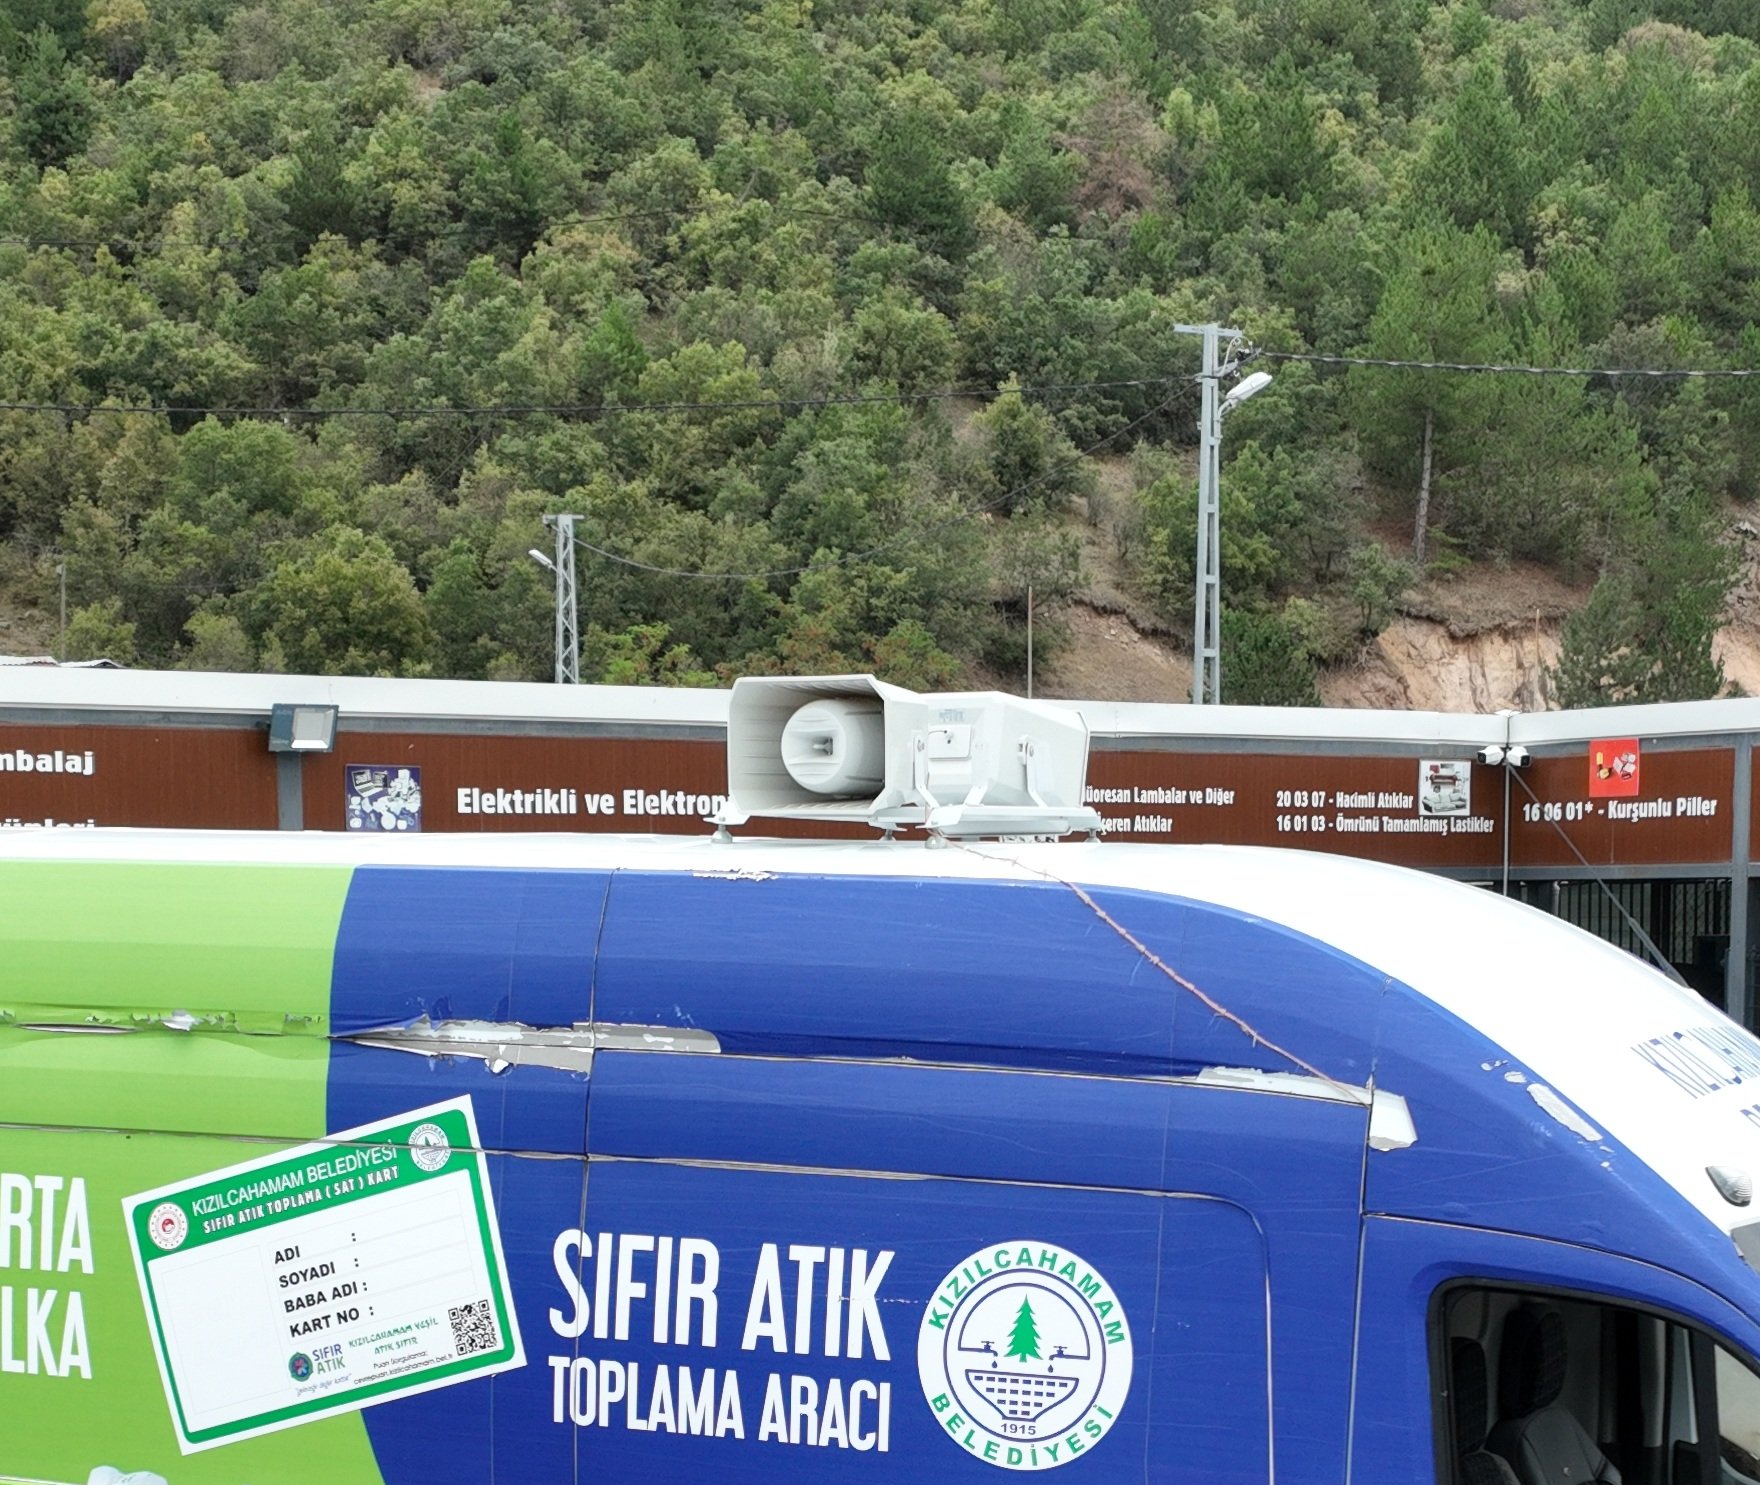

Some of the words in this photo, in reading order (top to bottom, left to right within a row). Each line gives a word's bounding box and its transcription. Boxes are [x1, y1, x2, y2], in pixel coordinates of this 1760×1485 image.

[457, 787, 576, 813] Elektrikli
[584, 793, 614, 814] ve
[623, 789, 727, 814] Elektron
[1085, 785, 1130, 803] üoresan
[1133, 786, 1186, 803] Lambalar
[1188, 790, 1202, 804] ve
[1205, 787, 1234, 805] Diğer
[1276, 790, 1291, 807] 20
[1293, 790, 1308, 807] 03
[1311, 790, 1325, 807] 07
[1336, 791, 1375, 808] Hacimli
[1377, 792, 1413, 808] Atıklar
[1523, 803, 1540, 821] 16
[1608, 797, 1672, 821] Kurşunlu
[1676, 796, 1717, 816] Piller
[1133, 814, 1172, 832] Atıklar
[1276, 814, 1291, 831] 16
[1293, 814, 1307, 831] 01
[1311, 815, 1325, 831] 03
[1335, 813, 1379, 832] Ömrünü
[1450, 816, 1494, 833] Lastikler
[192, 1169, 304, 1216] KIZILCAHAMAM
[306, 1140, 399, 1183] BELEDİYESİ
[204, 1213, 234, 1233] SIFIR
[239, 1205, 264, 1223] ATIK
[266, 1188, 322, 1214] TOPLAMA
[334, 1178, 354, 1195] SAT
[367, 1165, 397, 1185] KART
[274, 1245, 300, 1264] ADI
[278, 1261, 335, 1288] SOYADI
[284, 1291, 327, 1312] BABA
[332, 1281, 357, 1300] ADI
[549, 1228, 719, 1347] SIFIR
[741, 1243, 895, 1360] ATIK
[928, 1247, 1126, 1344] KIZILCAHAMAM
[289, 1314, 331, 1337] KART
[336, 1307, 359, 1324] NO
[312, 1343, 342, 1361] SIFIR
[317, 1355, 345, 1374] ATIK
[548, 1355, 744, 1439] TOPLAMA
[758, 1373, 890, 1451] ARACI
[931, 1392, 1113, 1466] BELEDİYESİ
[1001, 1423, 1036, 1435] 1915
